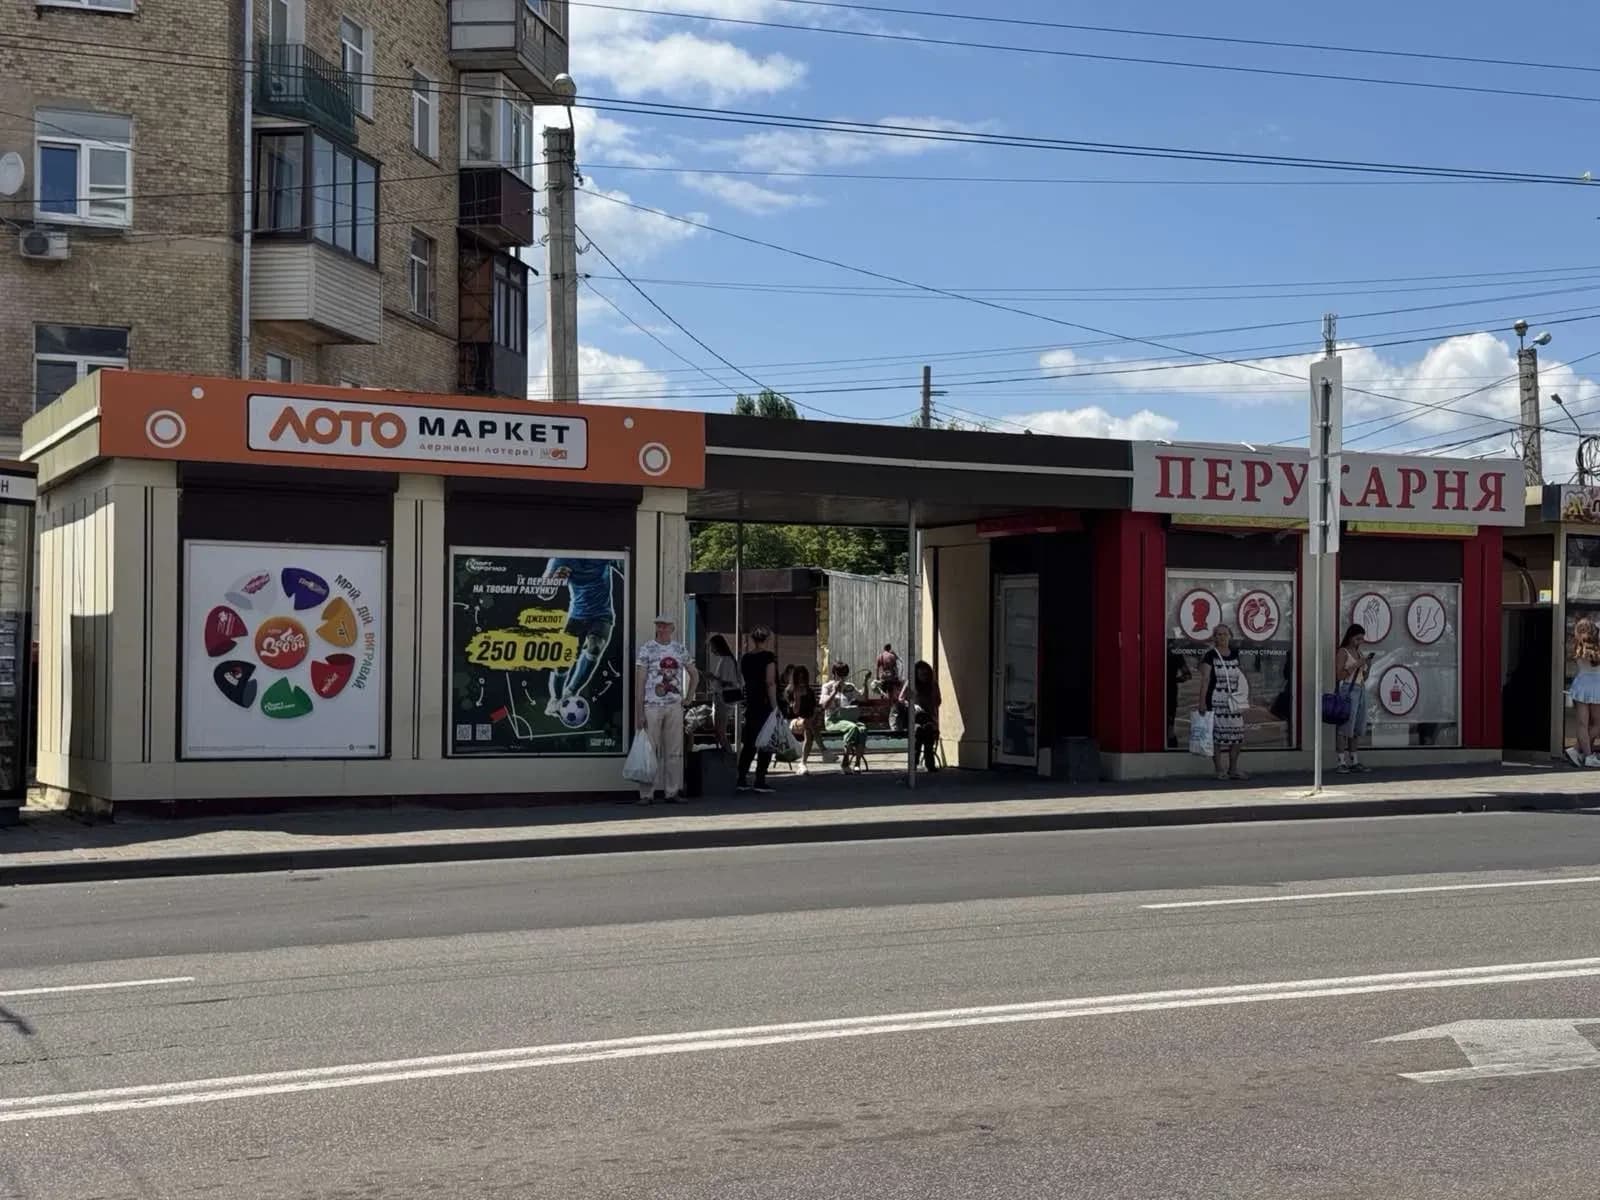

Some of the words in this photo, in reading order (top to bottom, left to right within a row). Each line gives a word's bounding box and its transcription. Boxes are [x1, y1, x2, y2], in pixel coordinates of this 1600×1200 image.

[269, 406, 407, 449] ЛОТО
[418, 416, 570, 444] МАРКЕТ
[516, 574, 526, 585] ЇХ
[527, 576, 568, 587] ПЕРЕМОГИ
[473, 584, 484, 593] НА
[486, 585, 518, 594] ТВОЄМУ
[525, 615, 564, 625] ДЖЕКПОТ
[476, 640, 517, 662] 250
